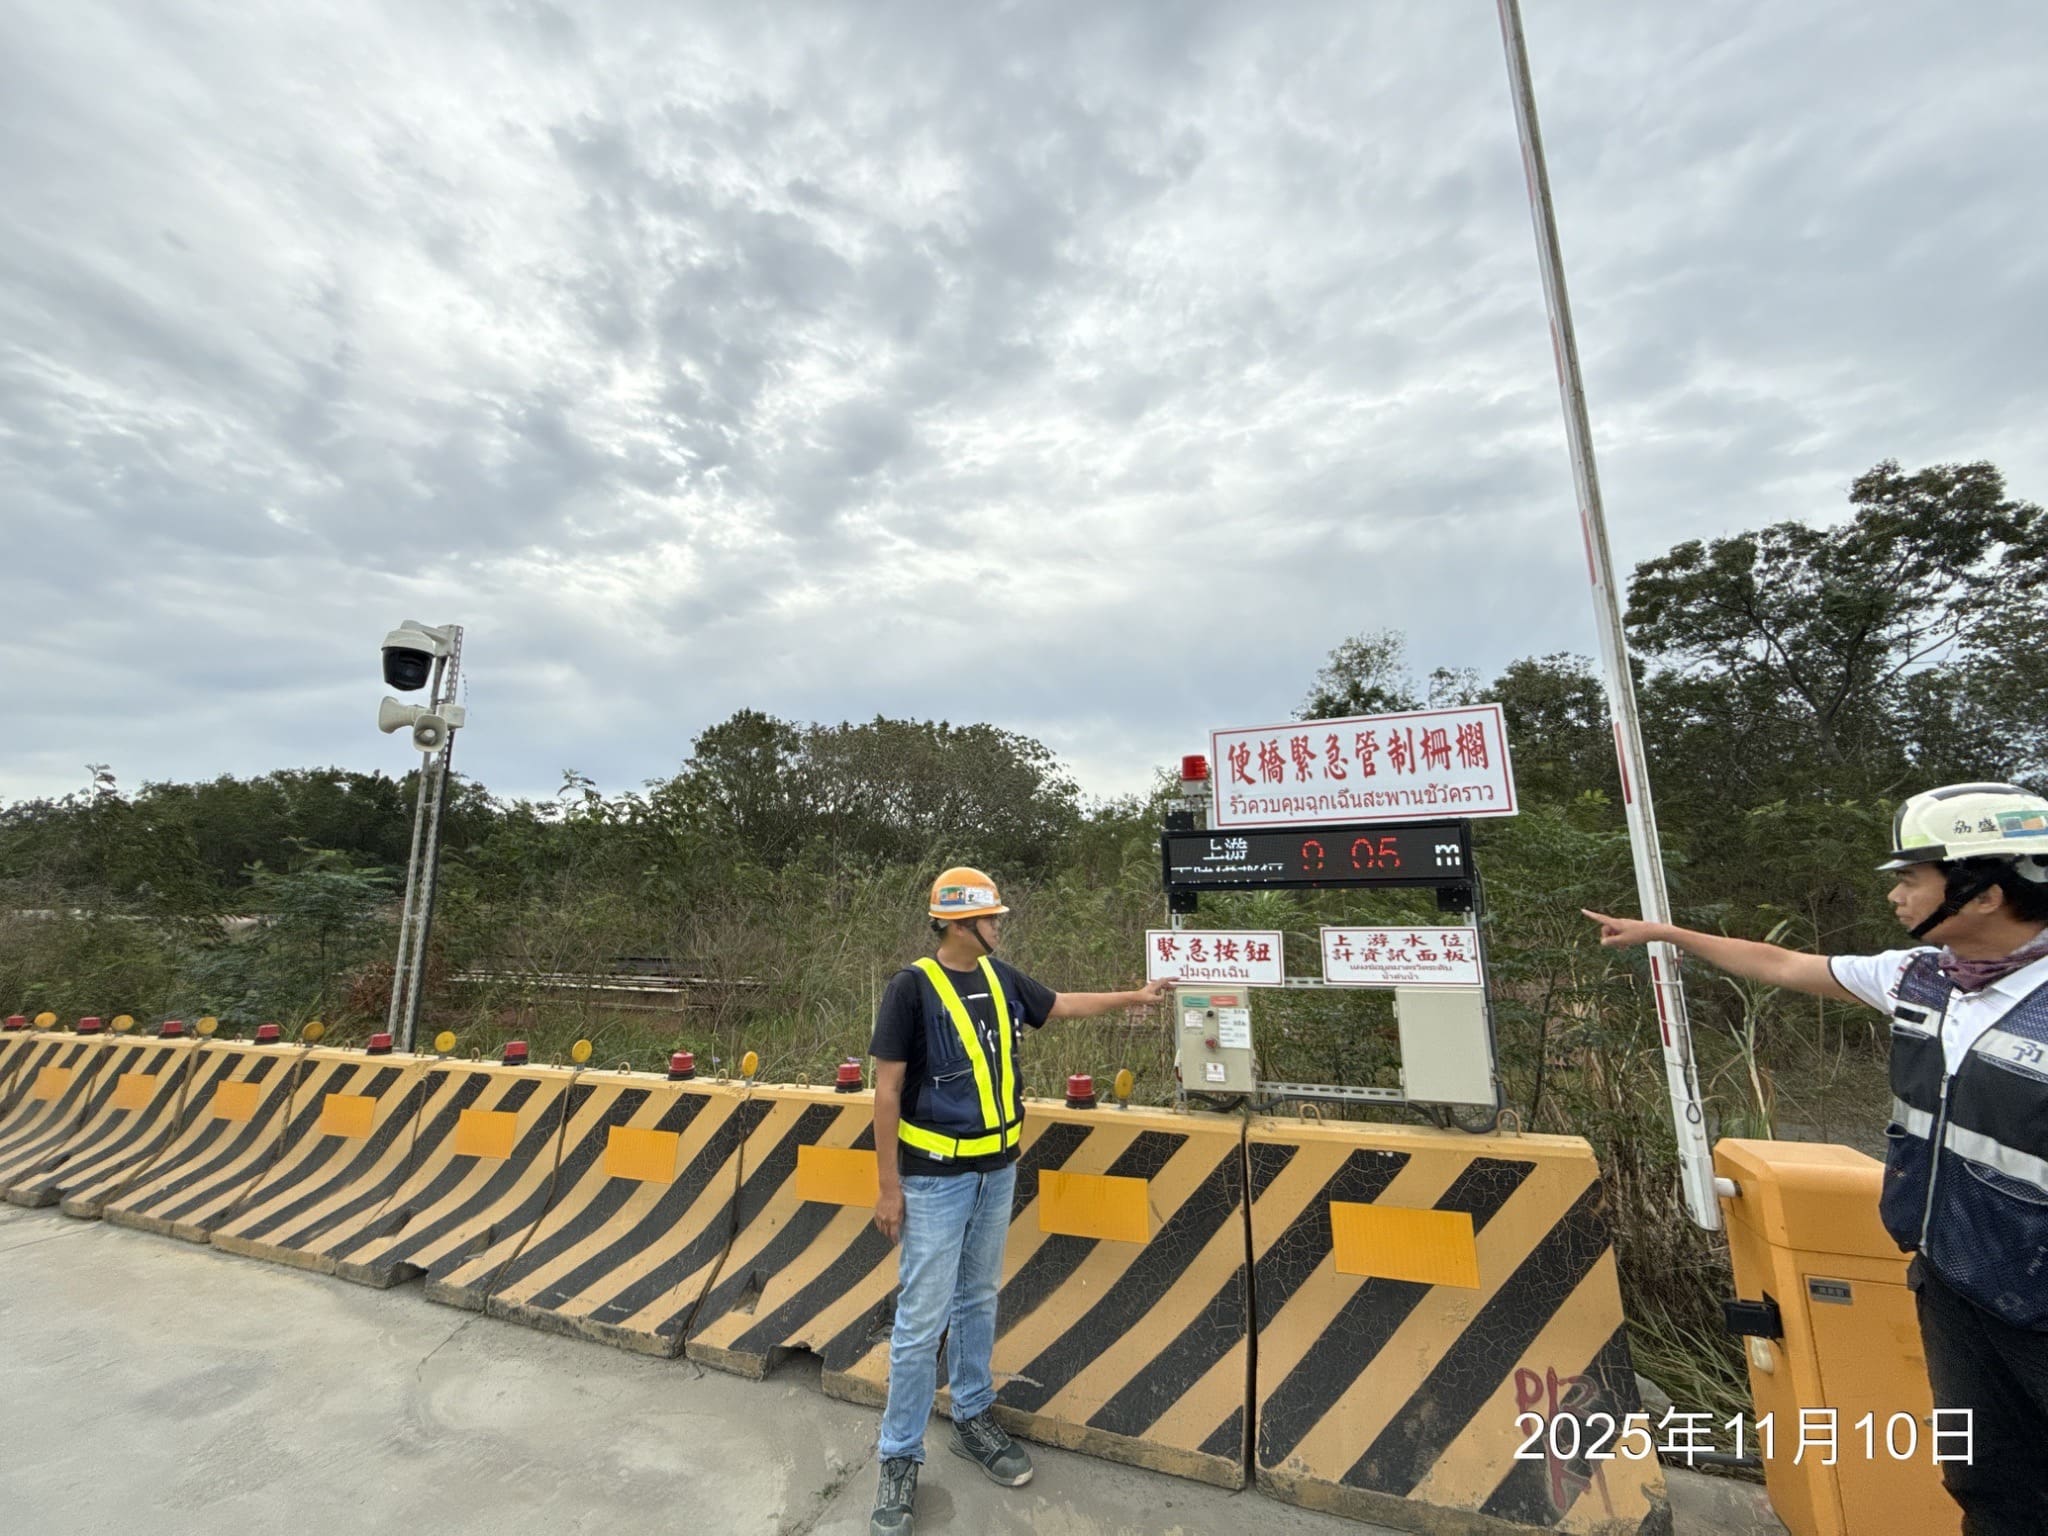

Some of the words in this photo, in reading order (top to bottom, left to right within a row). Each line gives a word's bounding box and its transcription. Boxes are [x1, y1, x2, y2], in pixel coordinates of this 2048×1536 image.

[1227, 720, 1489, 785] 便橋緊急管制柵欄
[1156, 936, 1272, 963] 緊急按鈕
[1333, 933, 1465, 947] 上游水位
[1331, 948, 1470, 963] 計資訊面板
